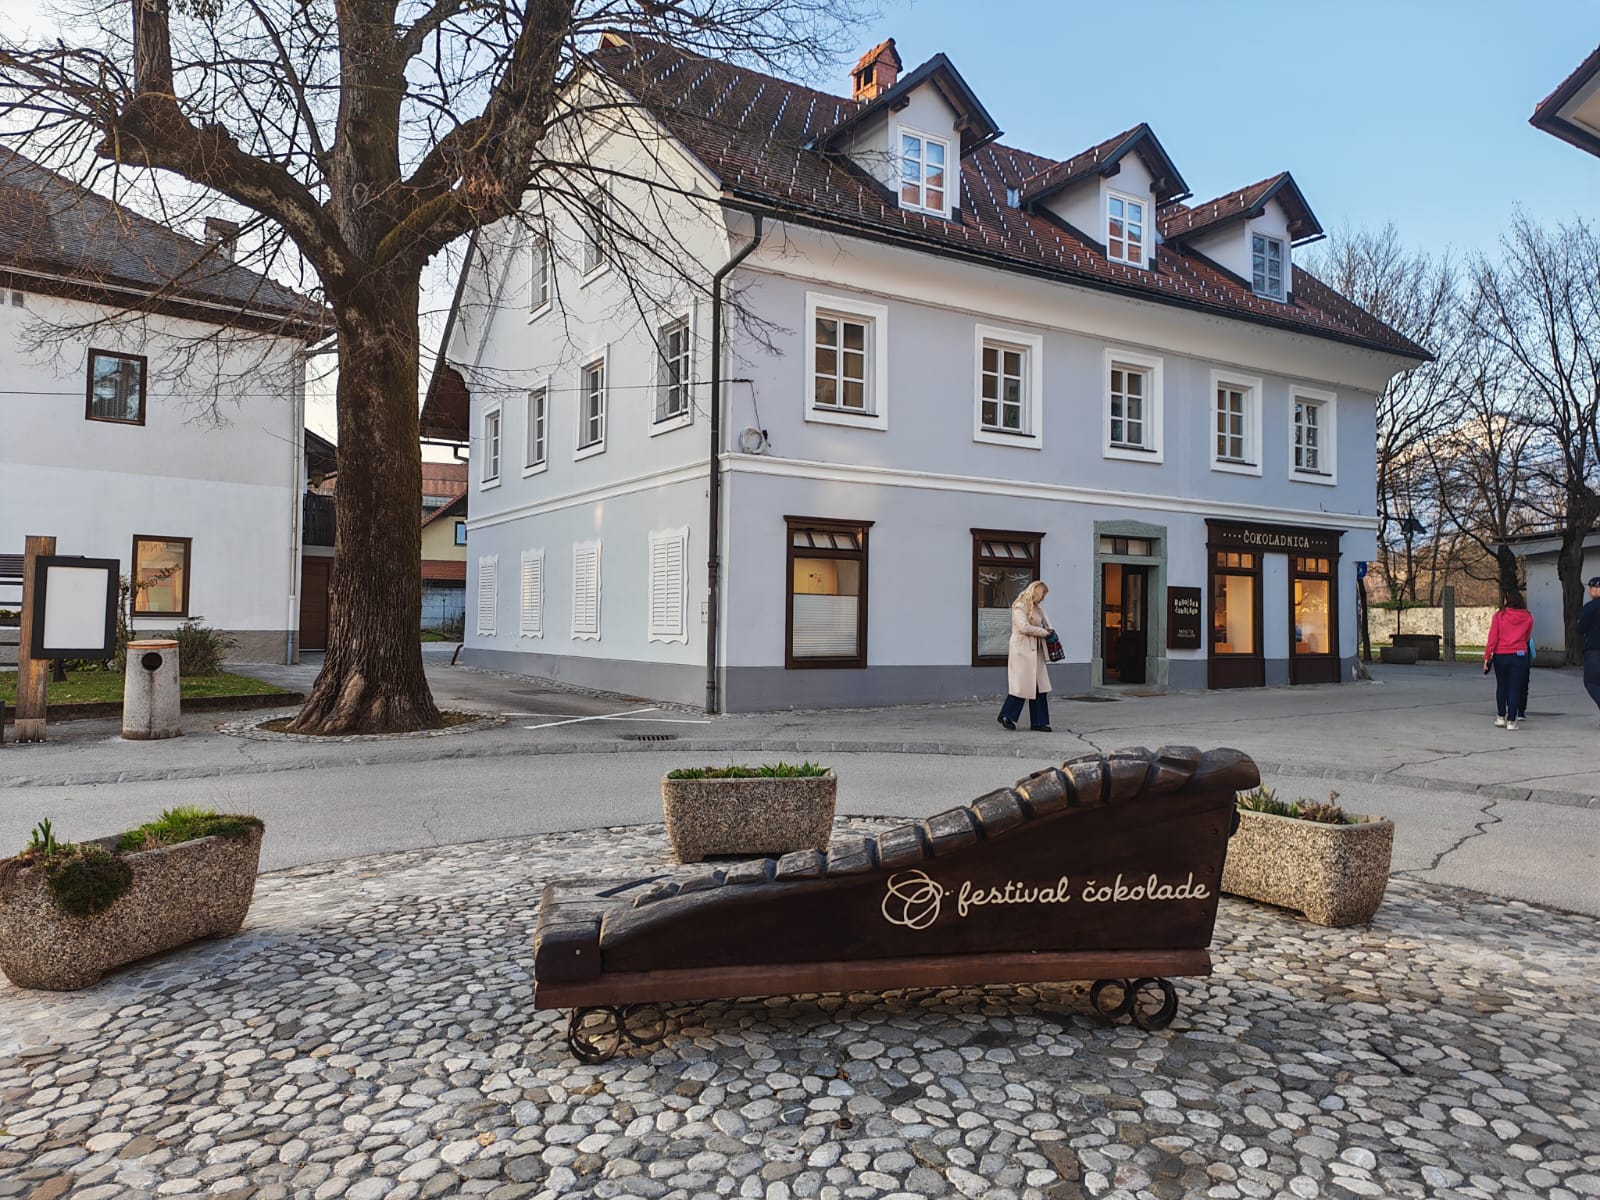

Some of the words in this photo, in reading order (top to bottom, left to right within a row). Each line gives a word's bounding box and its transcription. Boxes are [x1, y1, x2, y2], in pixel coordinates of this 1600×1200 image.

[1243, 529, 1310, 548] ČOKOLADNICA
[957, 875, 1071, 917] festival
[1081, 872, 1211, 903] čokolade
